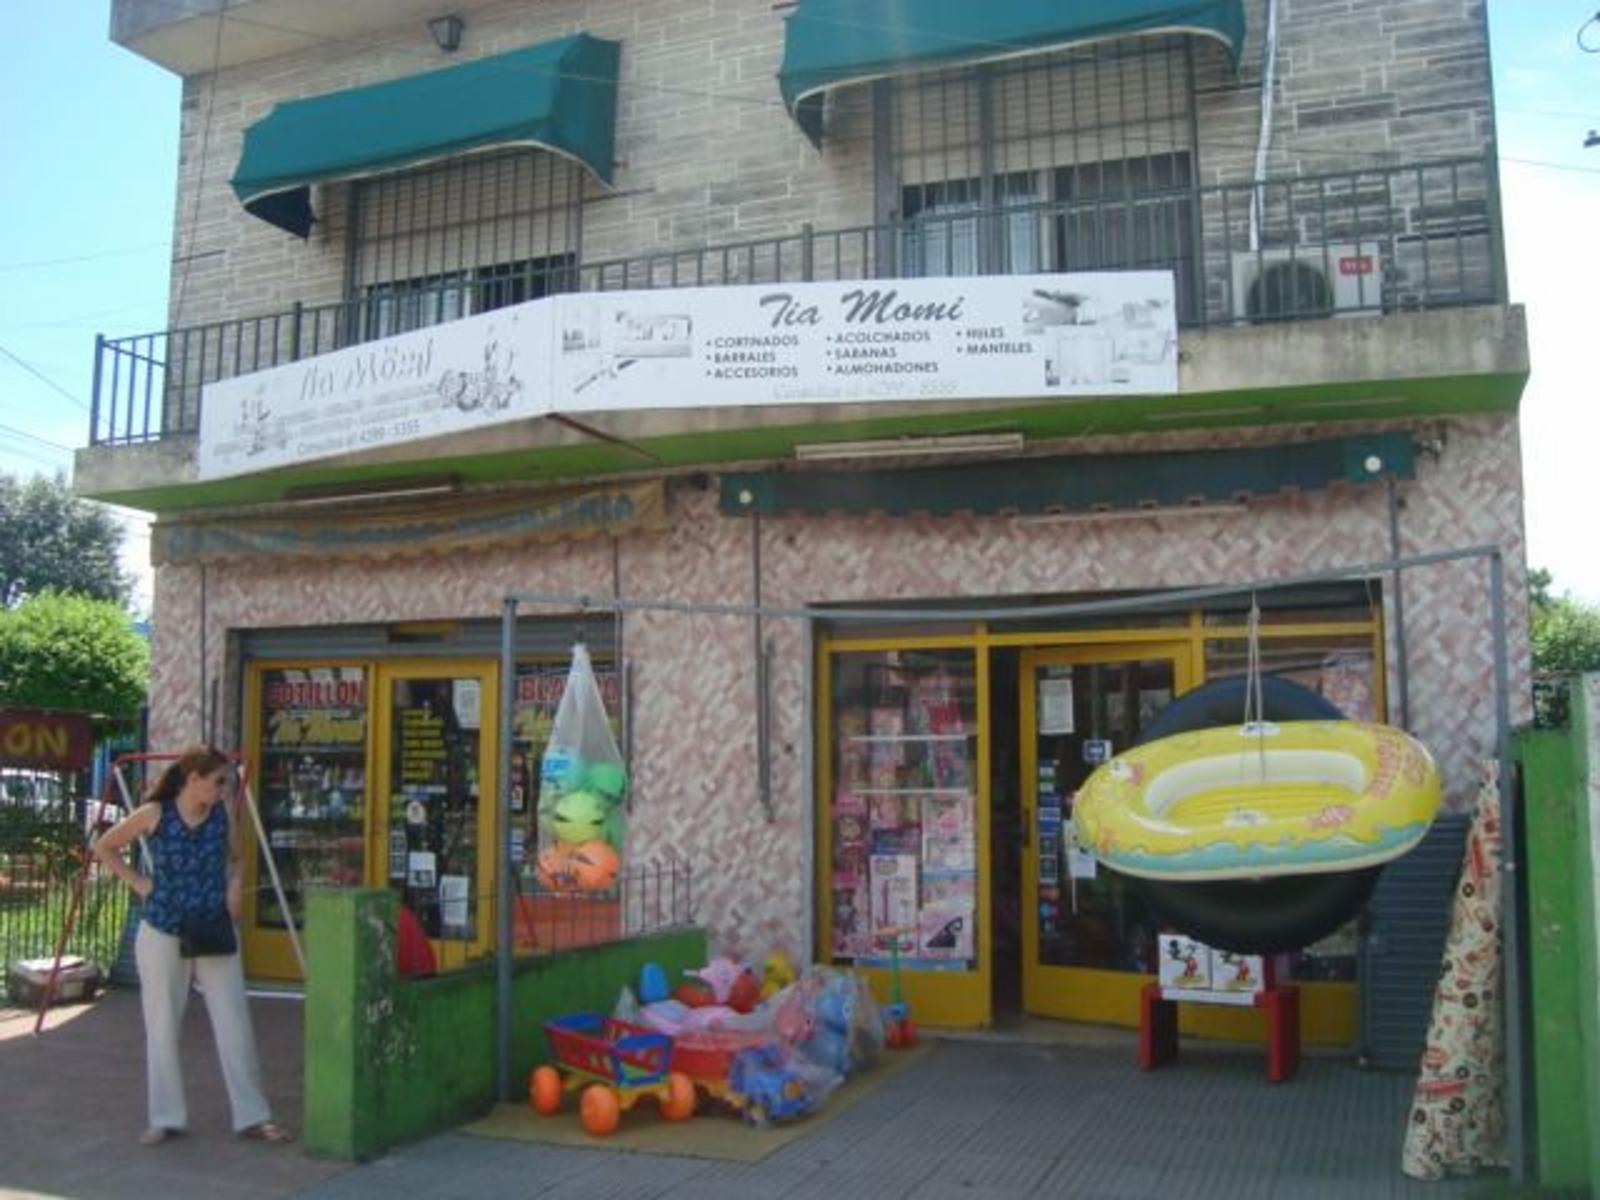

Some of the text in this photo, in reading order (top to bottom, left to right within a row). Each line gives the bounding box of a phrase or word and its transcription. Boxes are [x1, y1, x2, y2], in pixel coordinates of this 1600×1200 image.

[760, 289, 964, 328] Tia Momi
[715, 336, 798, 348] CORTINADOS
[835, 331, 931, 343] ACOLCHADOS
[967, 342, 1031, 354] MANTELES
[715, 352, 776, 363] BARRALES
[715, 366, 798, 378] ACCESORIOS
[835, 362, 939, 374] ALMOHADONES
